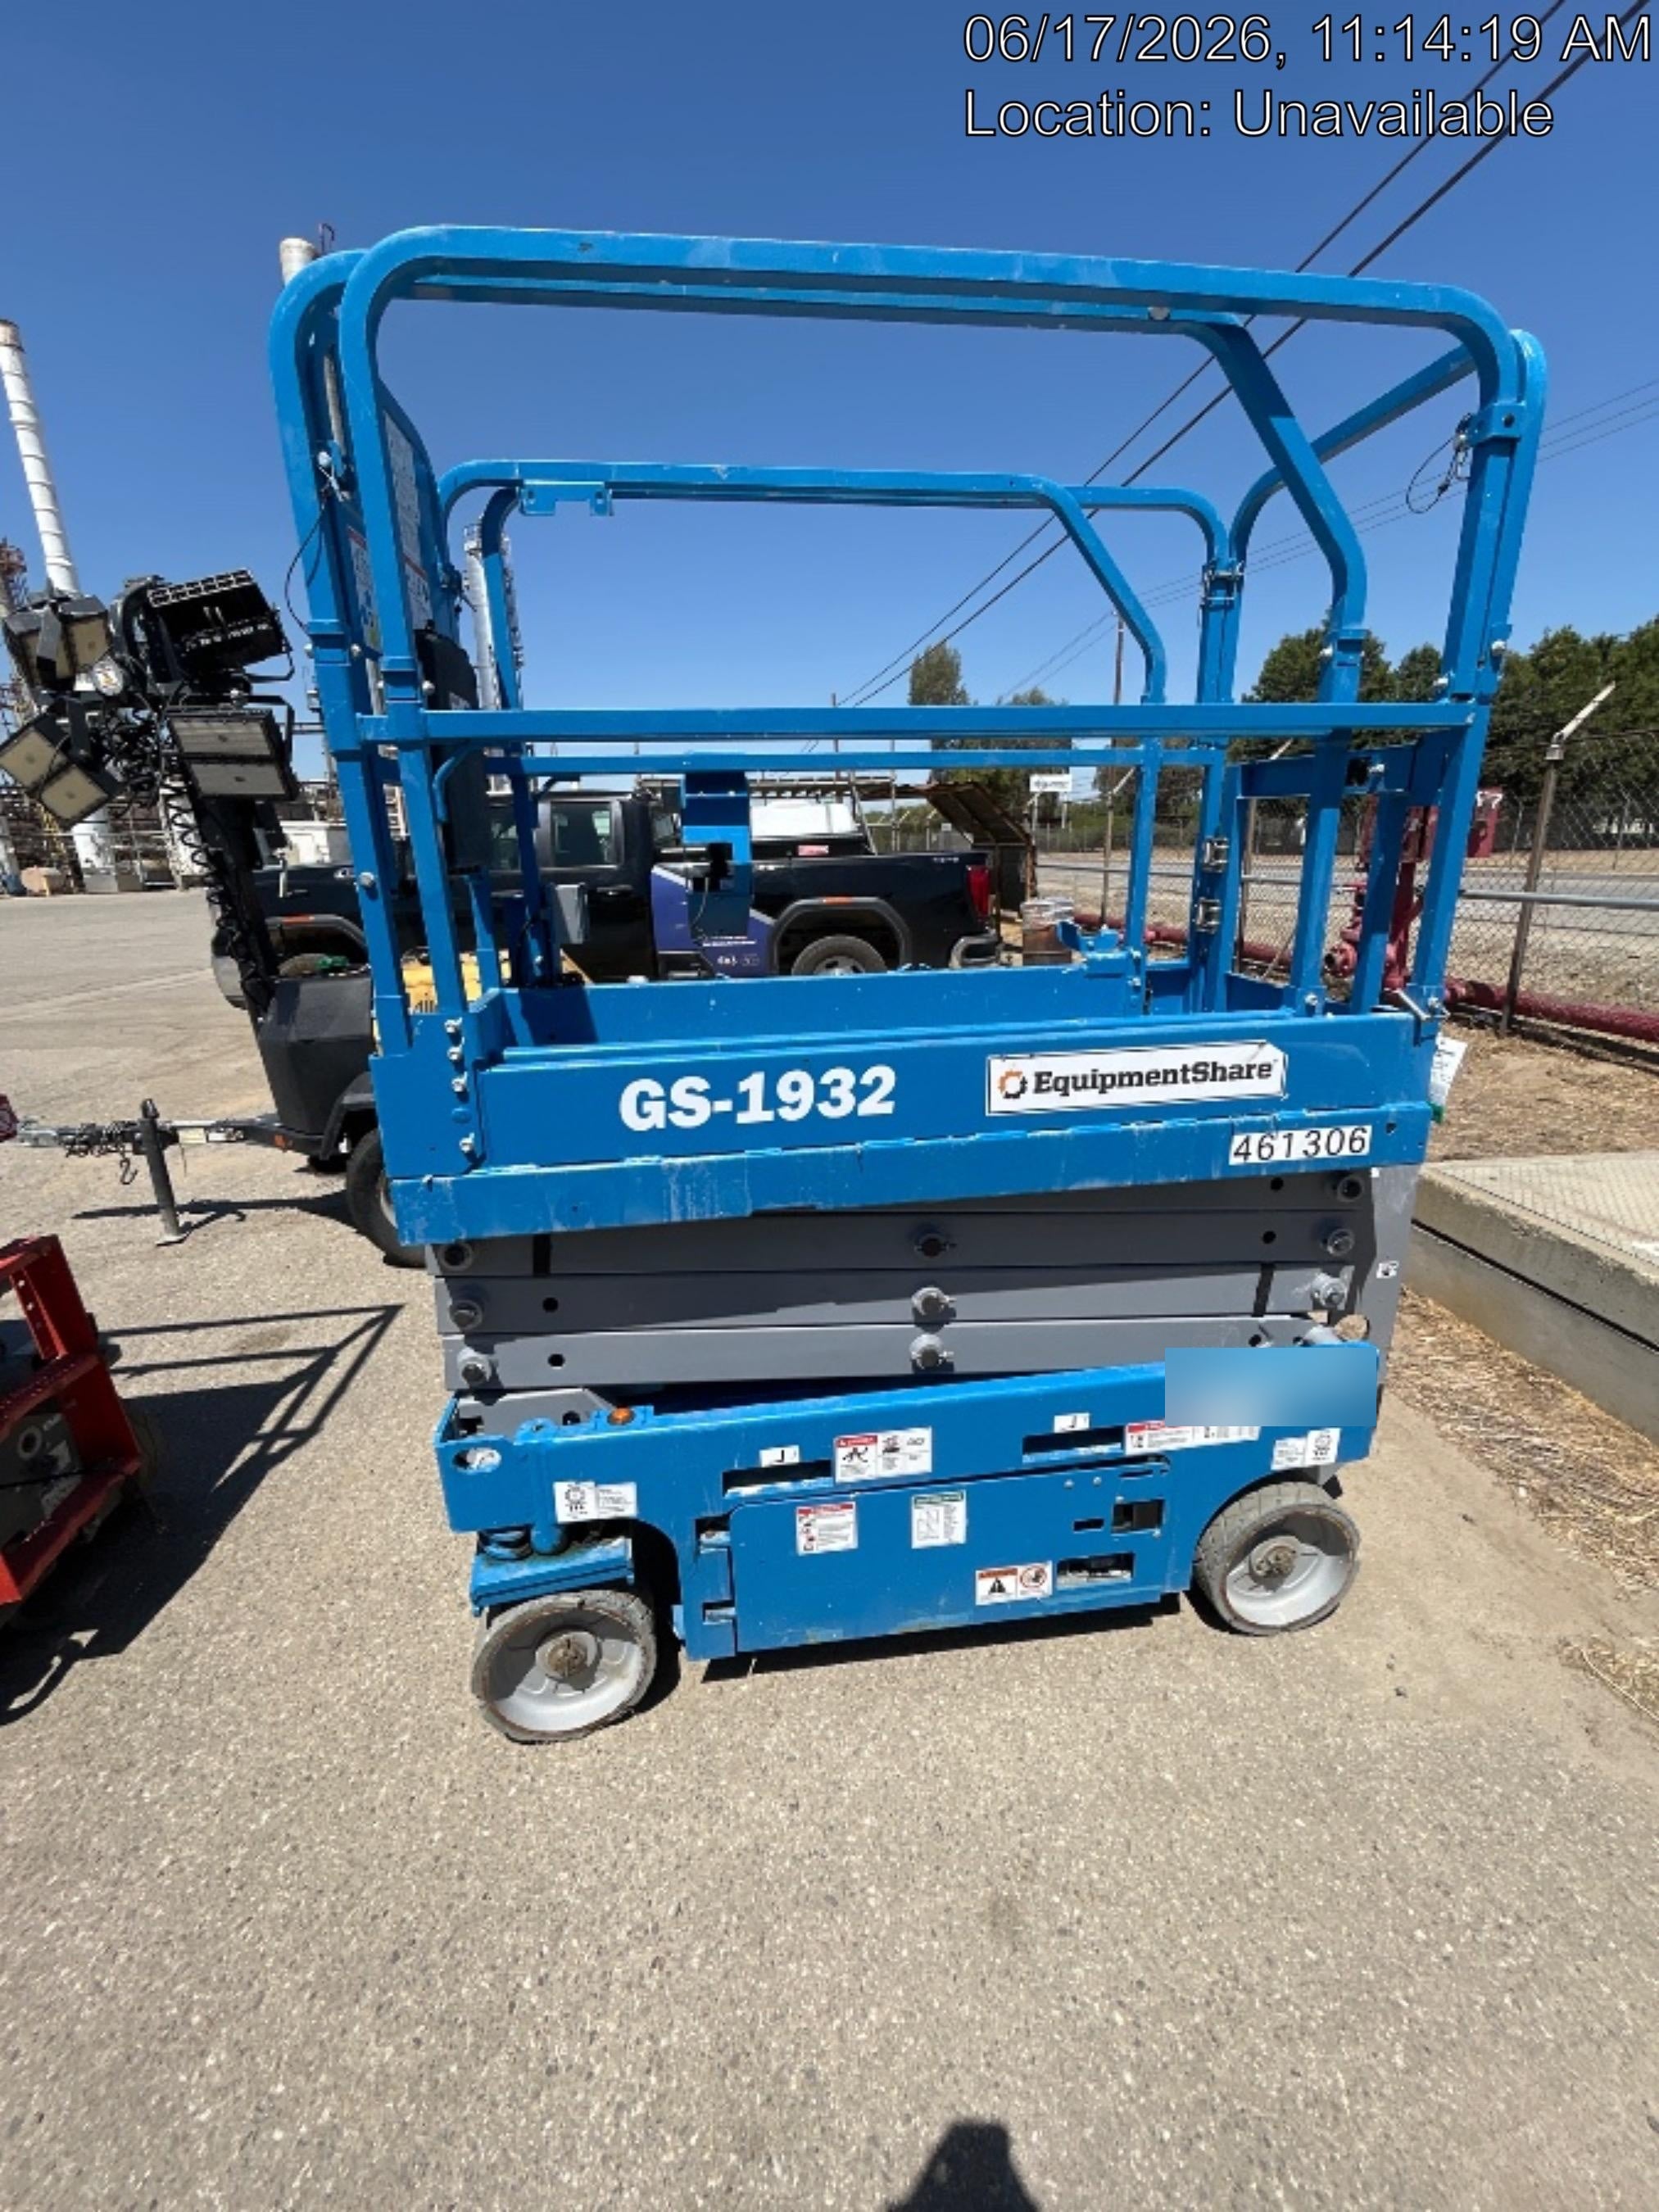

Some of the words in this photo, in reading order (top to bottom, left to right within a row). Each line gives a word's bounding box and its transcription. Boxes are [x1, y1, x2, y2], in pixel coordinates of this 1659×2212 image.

[1033, 1060, 1273, 1096] EquipmentShare
[619, 1064, 896, 1132] GS-1932
[1233, 1127, 1368, 1162] 461306
